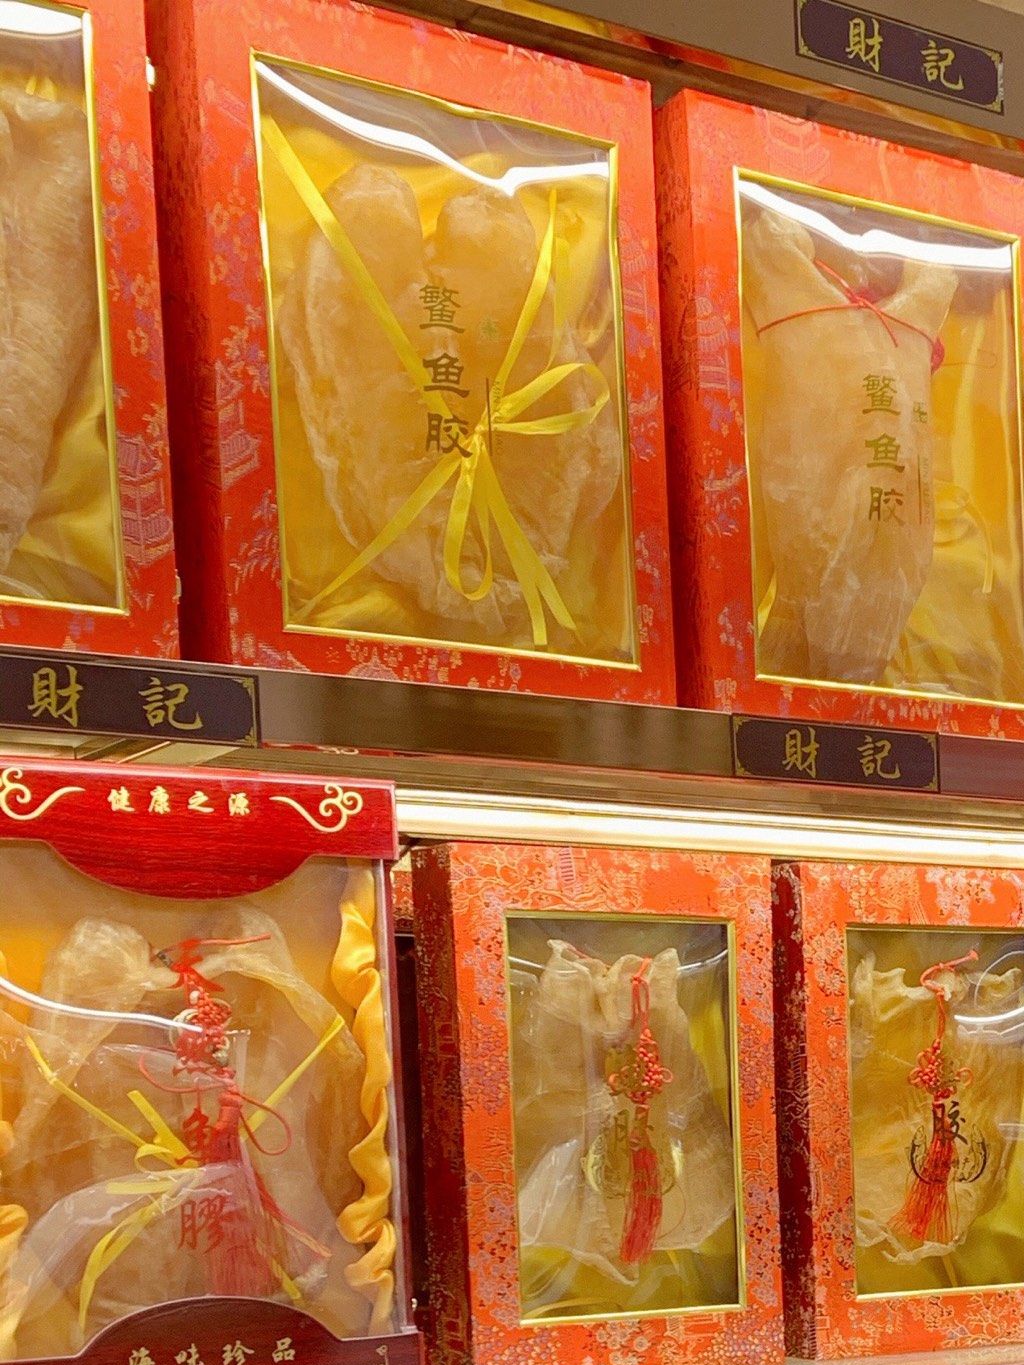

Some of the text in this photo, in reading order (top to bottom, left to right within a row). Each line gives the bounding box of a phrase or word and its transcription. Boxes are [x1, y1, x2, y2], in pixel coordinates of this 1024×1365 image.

[845, 18, 965, 93] 財記
[28, 664, 204, 731] 財記
[782, 726, 901, 780] 財記
[107, 785, 251, 817] 健康之源
